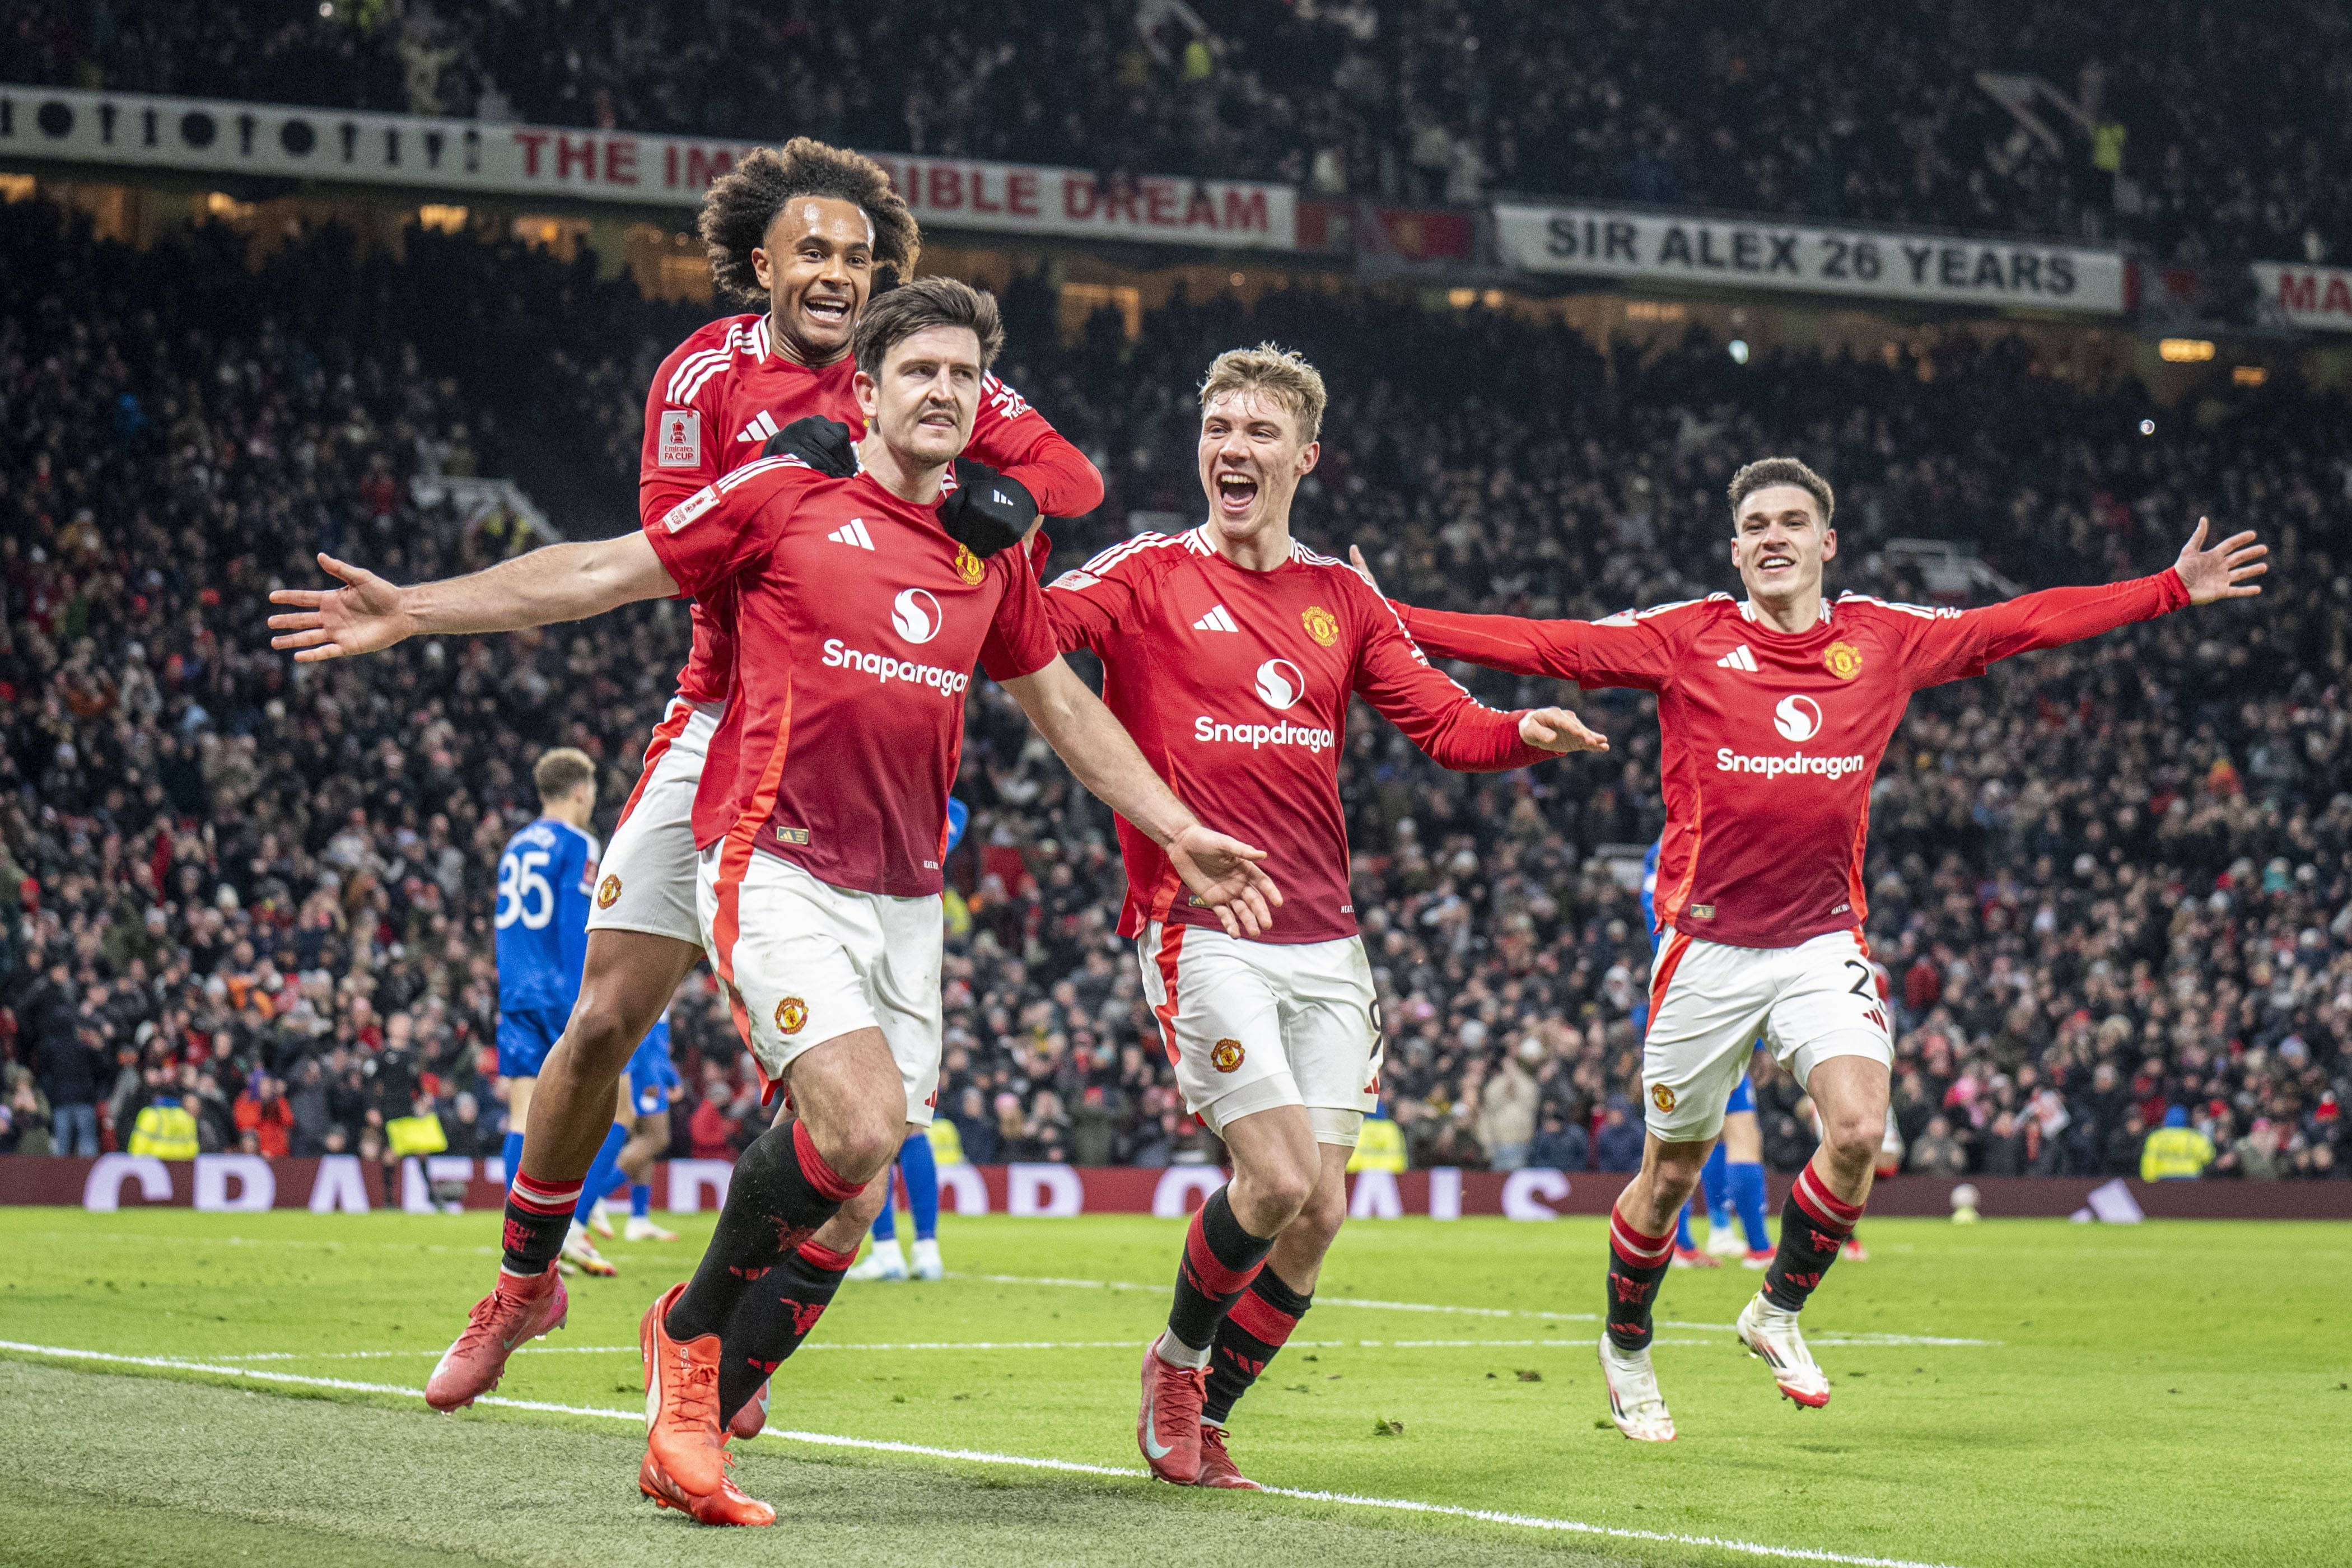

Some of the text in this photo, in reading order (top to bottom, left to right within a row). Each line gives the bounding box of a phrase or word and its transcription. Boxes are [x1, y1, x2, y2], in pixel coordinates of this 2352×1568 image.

[514, 131, 640, 185] THE
[1063, 178, 1268, 231] DREAM
[1546, 217, 2077, 296] SIR ALEX 26 YEARS
[1716, 748, 1864, 780] Snapdragon
[494, 852, 554, 930] 35
[1845, 960, 1883, 1011] 2
